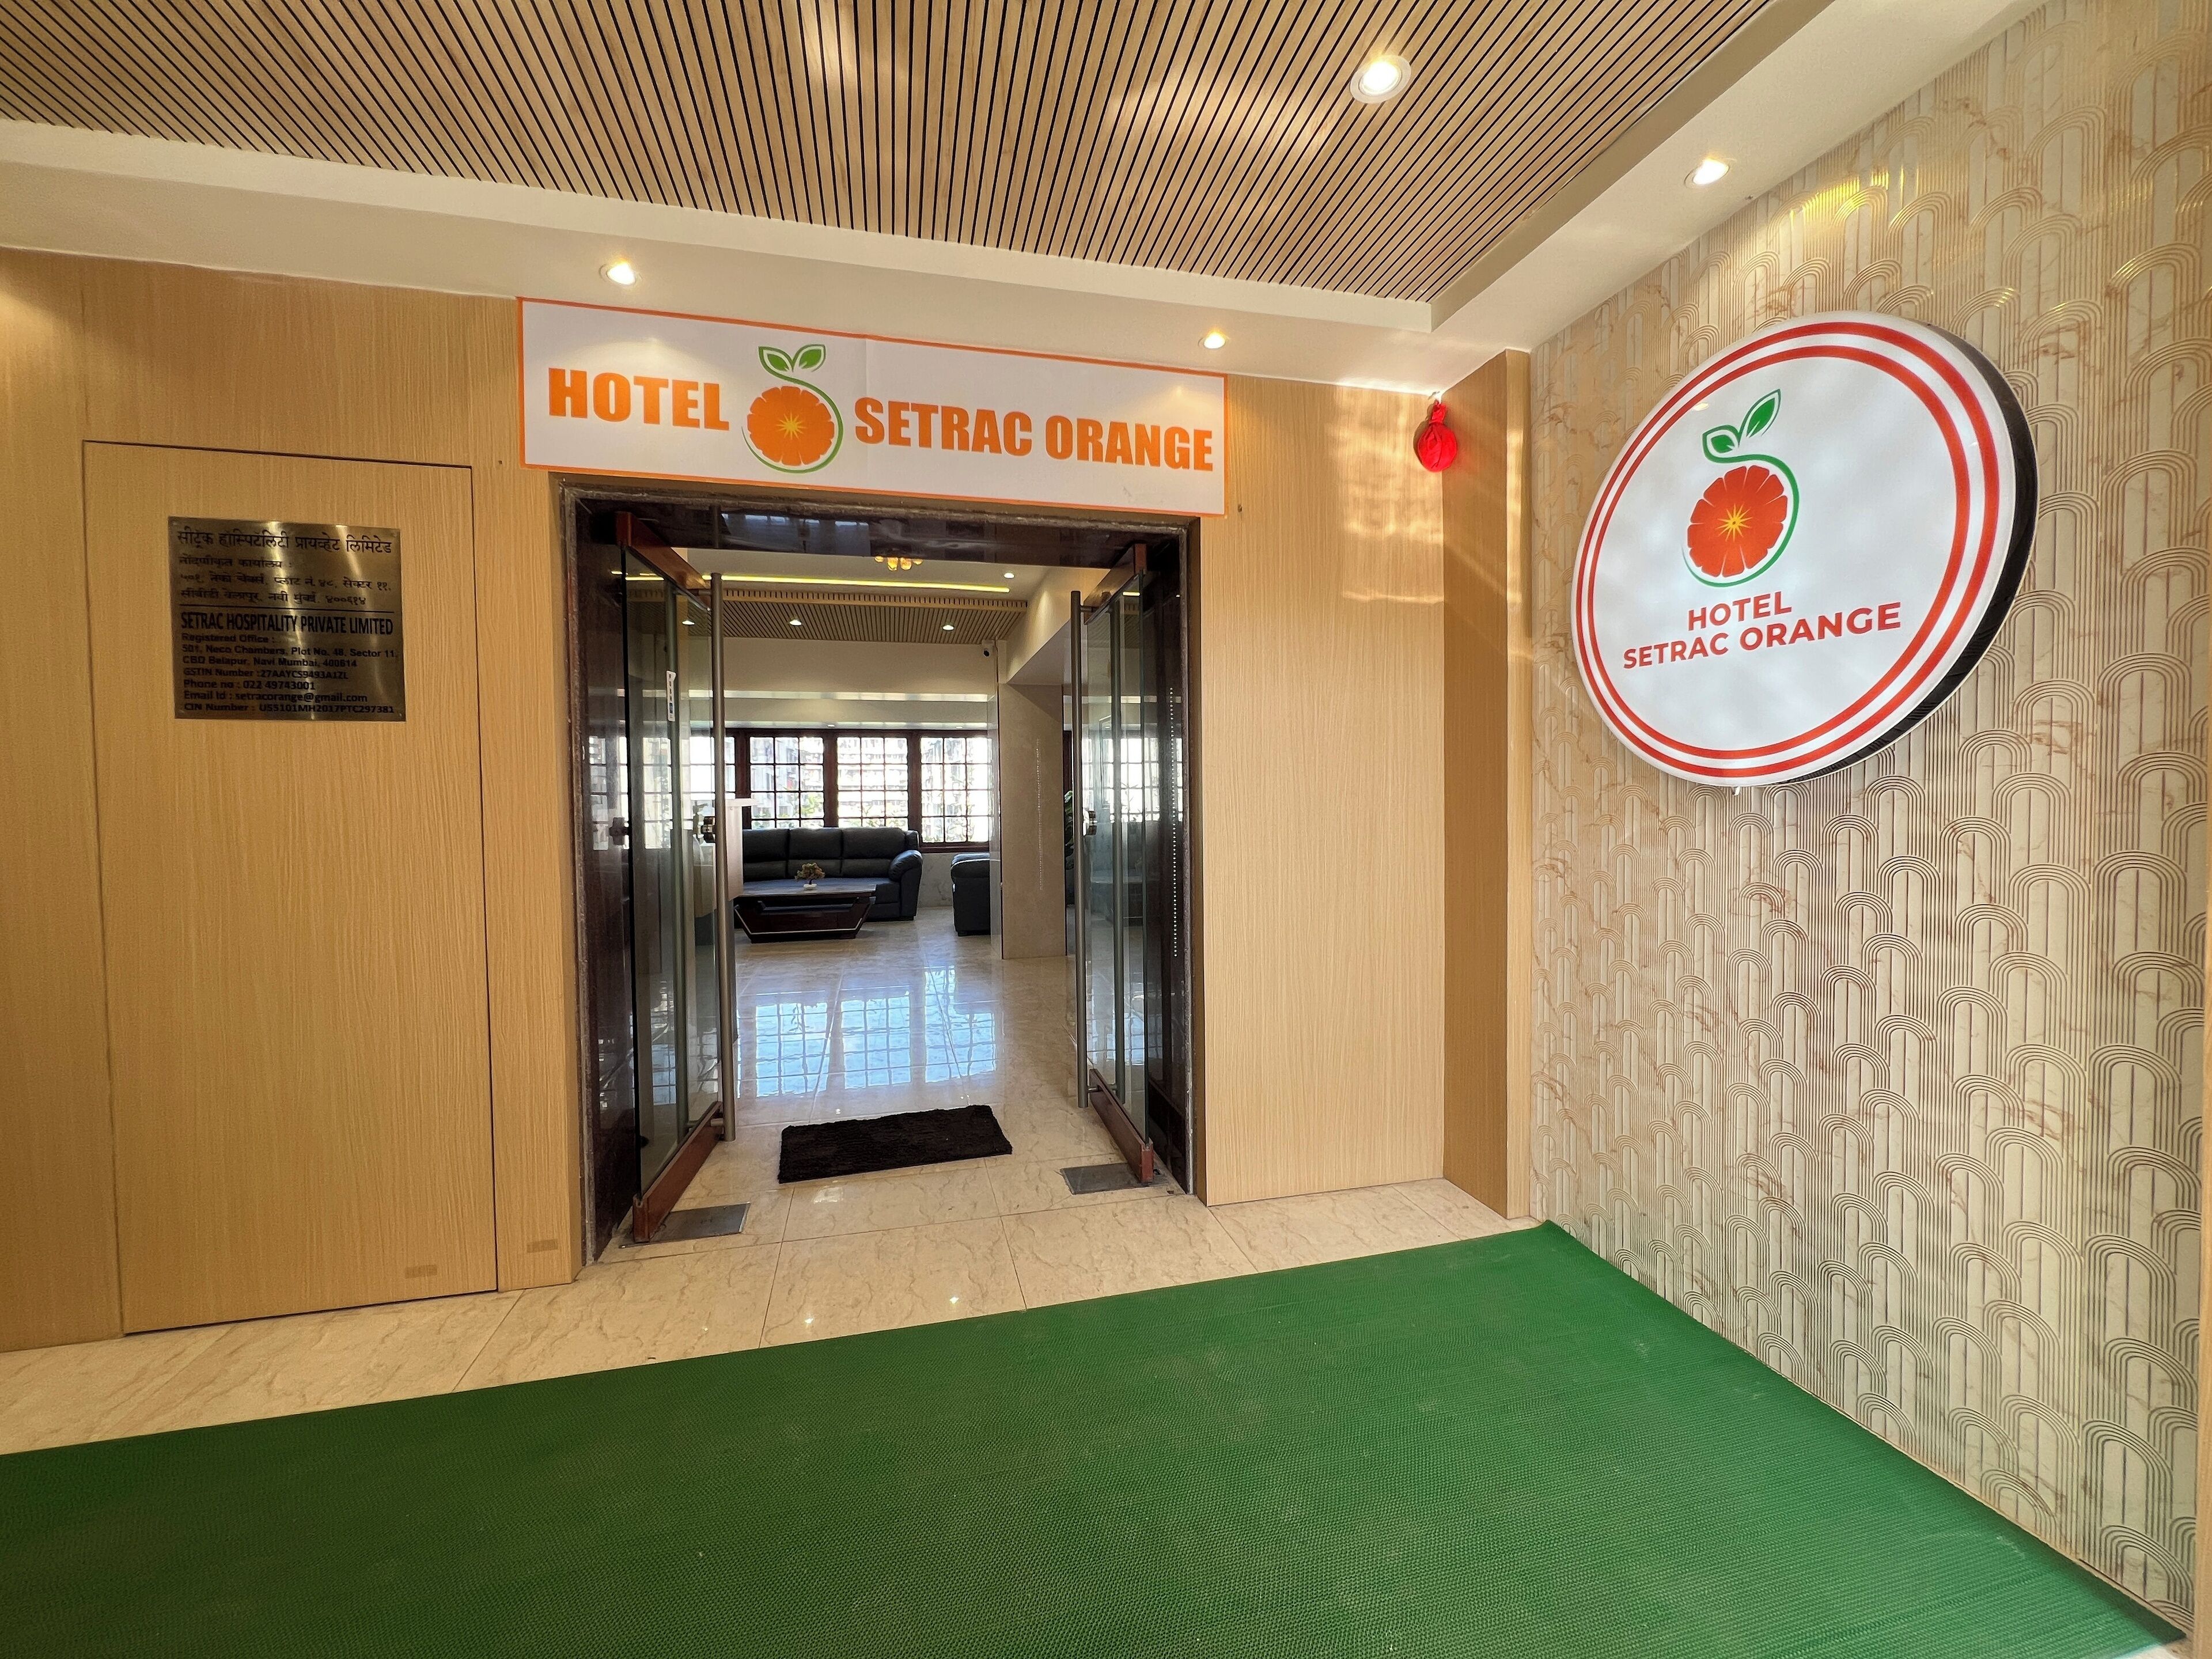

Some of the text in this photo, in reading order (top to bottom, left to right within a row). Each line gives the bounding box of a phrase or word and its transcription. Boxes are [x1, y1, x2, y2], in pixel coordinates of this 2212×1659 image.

[549, 368, 1213, 472] HOTEL SETRAC ORANGE
[346, 535, 392, 553] लिमिटेड
[1688, 592, 1792, 631] HOTEL
[181, 612, 393, 634] SETRAC HOSPITALITY PRIVATE LIMITED
[182, 633, 236, 643] Registered
[240, 634, 268, 642] Office
[1623, 602, 1902, 669] SETRAC ORANGE
[291, 647, 310, 655] Plot
[350, 649, 381, 657] Sector
[253, 657, 275, 665] Navi
[184, 679, 217, 688] Phone
[244, 681, 262, 689] 022
[184, 691, 212, 699] Email
[236, 692, 368, 703] setracorange@gmail.com
